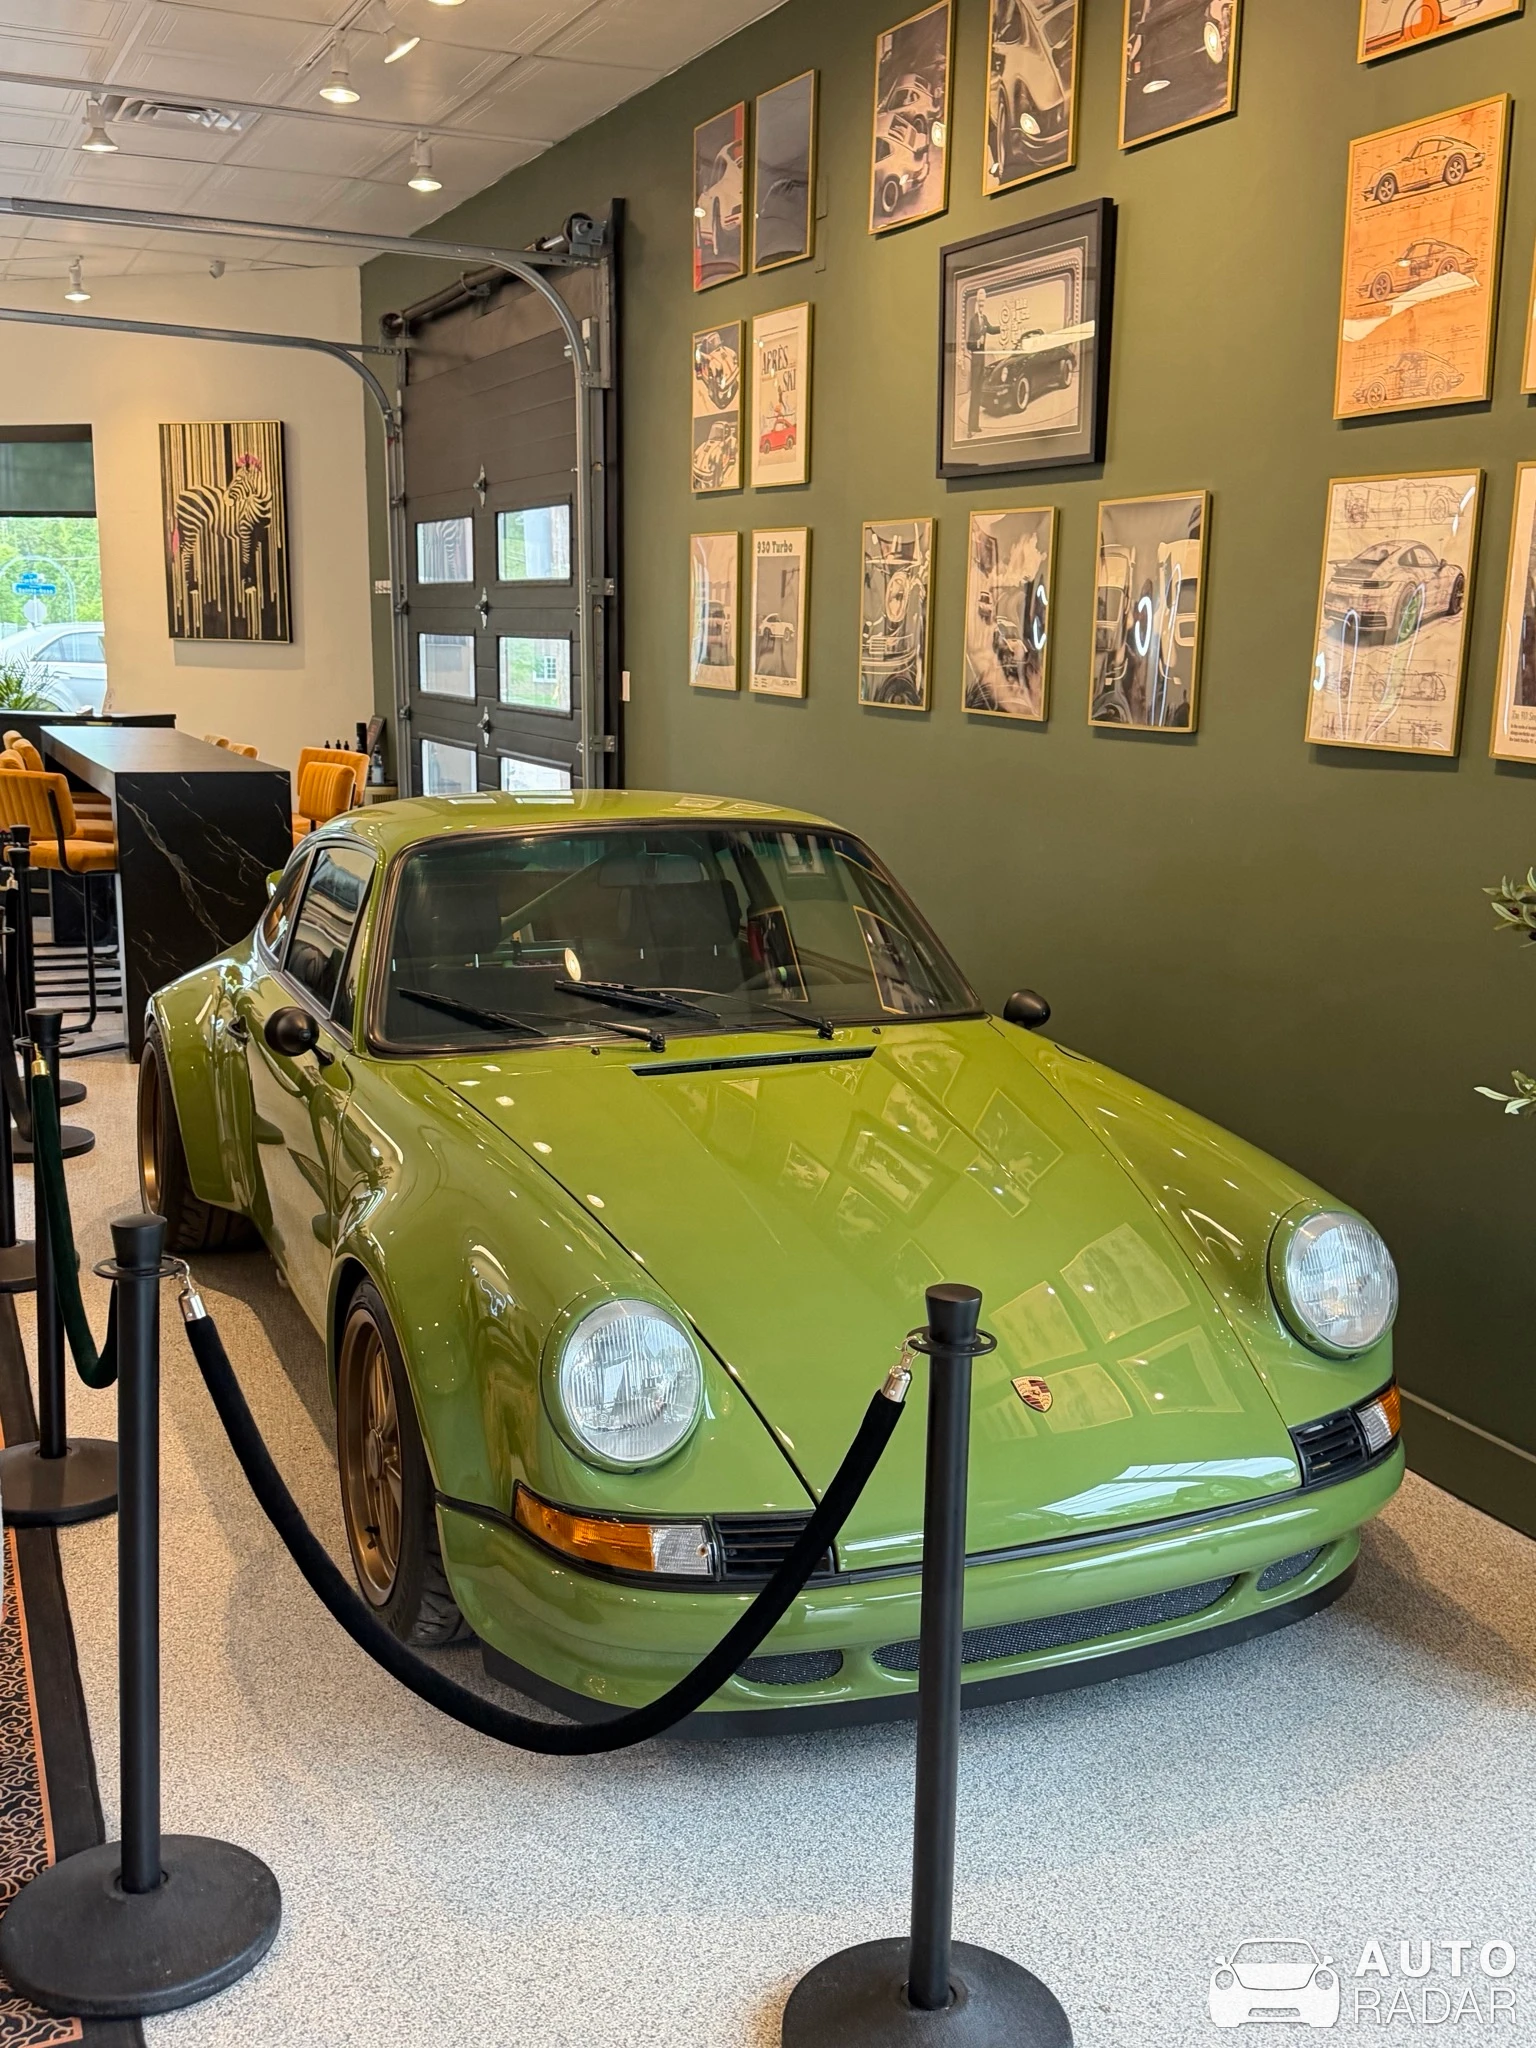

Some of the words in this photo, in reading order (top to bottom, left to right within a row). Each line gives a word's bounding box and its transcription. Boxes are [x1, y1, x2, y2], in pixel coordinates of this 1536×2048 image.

[761, 344, 789, 376] APRÈS
[782, 368, 797, 393] SKI
[757, 541, 771, 554] 930
[772, 540, 793, 553] Turbo
